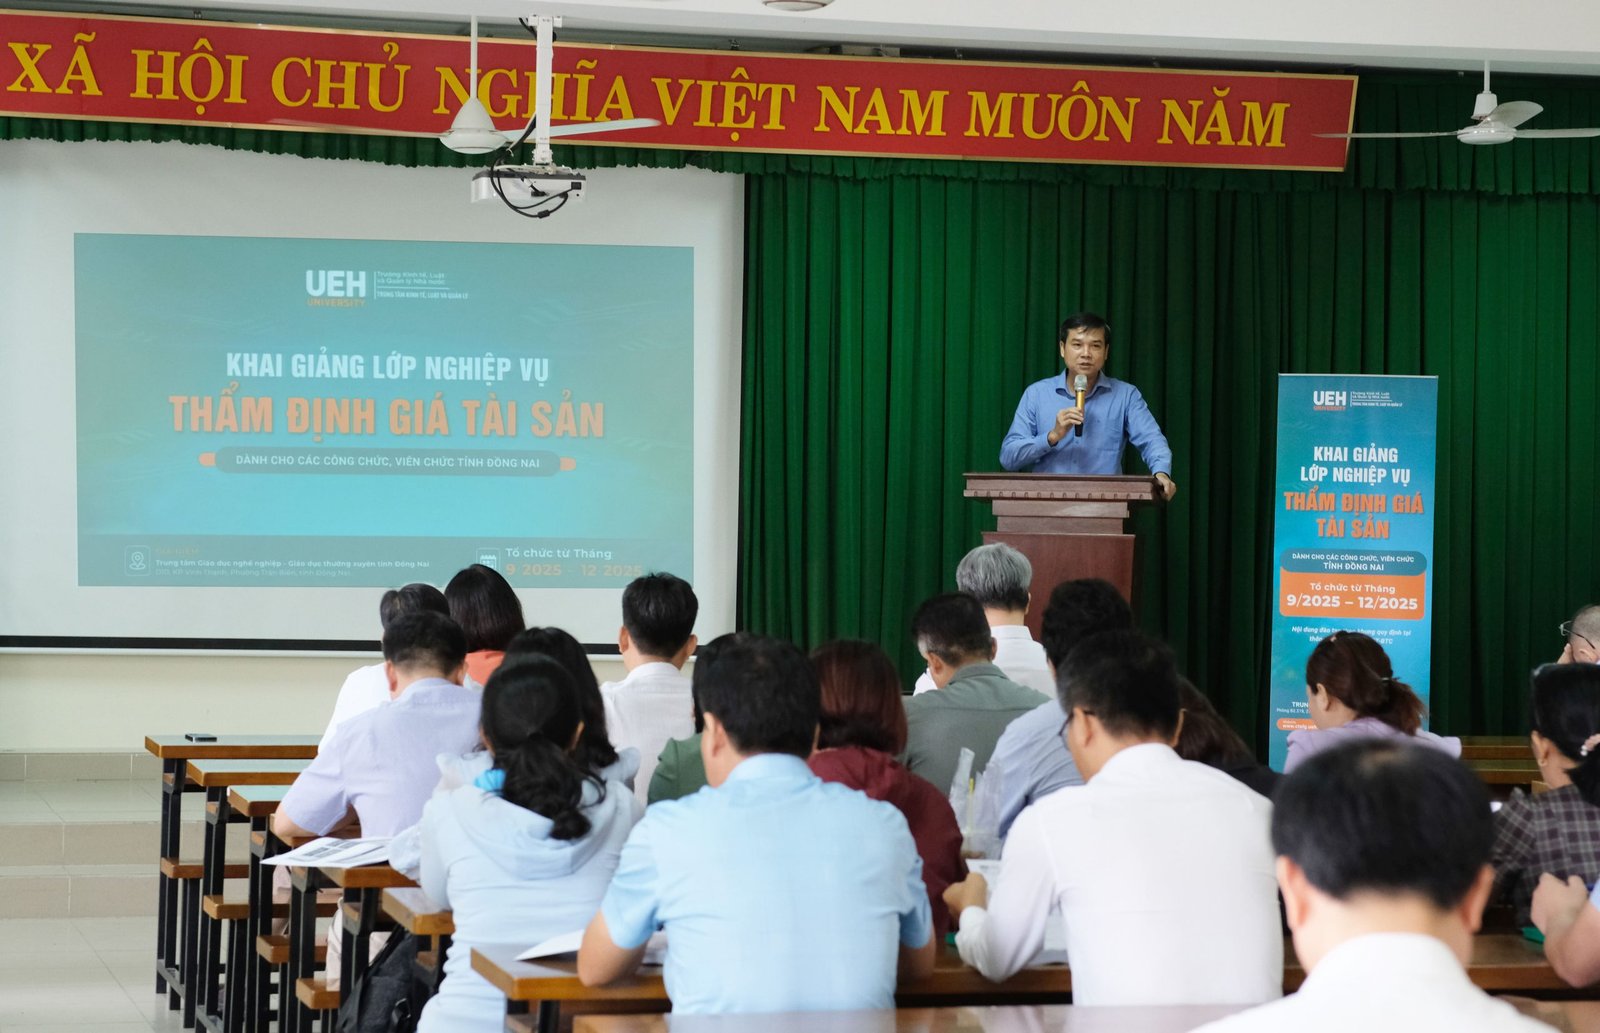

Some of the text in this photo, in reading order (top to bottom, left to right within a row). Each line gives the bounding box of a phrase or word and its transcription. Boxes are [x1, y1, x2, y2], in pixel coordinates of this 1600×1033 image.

[6, 33, 1290, 147] XÃ HỘI CHỦ NGHĨA VIỆT NAM MUÔN NĂM
[306, 270, 366, 297] UEH
[307, 298, 366, 308] UNIVERSITY
[226, 346, 549, 387] KHAI GIẢNG LỚP NGHIỆP VỤ
[1313, 391, 1346, 406] UEH
[169, 380, 604, 442] THẨM ĐỊNH GIÁ TÀI SẢN
[235, 454, 540, 468] DÀNH CHO CÁC CÔNG CHỨC, VIÊN CHỨC TỈNH ĐỒNG NAI
[1313, 443, 1398, 463] KHAI GIẢNG
[1301, 464, 1411, 487] LỚP NGHIỆP VỤ
[1284, 485, 1424, 515] THẨM ĐỊNH GIÁ
[1316, 515, 1390, 539] TÀI SẢN
[505, 547, 612, 560] Tổ chức từ Tháng
[1292, 552, 1311, 560] DÀNH
[1326, 553, 1339, 561] CÁC
[1340, 553, 1358, 561] CÔNG
[1359, 553, 1379, 562] CHỨC,
[1380, 554, 1398, 562] VIÊN
[1398, 554, 1414, 563] CHỨC
[417, 560, 430, 568] Nai
[1323, 562, 1343, 570] TỈNH
[1345, 562, 1368, 571] ĐỒNG
[1310, 582, 1396, 594] Tổ chức từ Tháng
[1286, 594, 1341, 608] 9/2025
[1358, 596, 1418, 610] 12/2025
